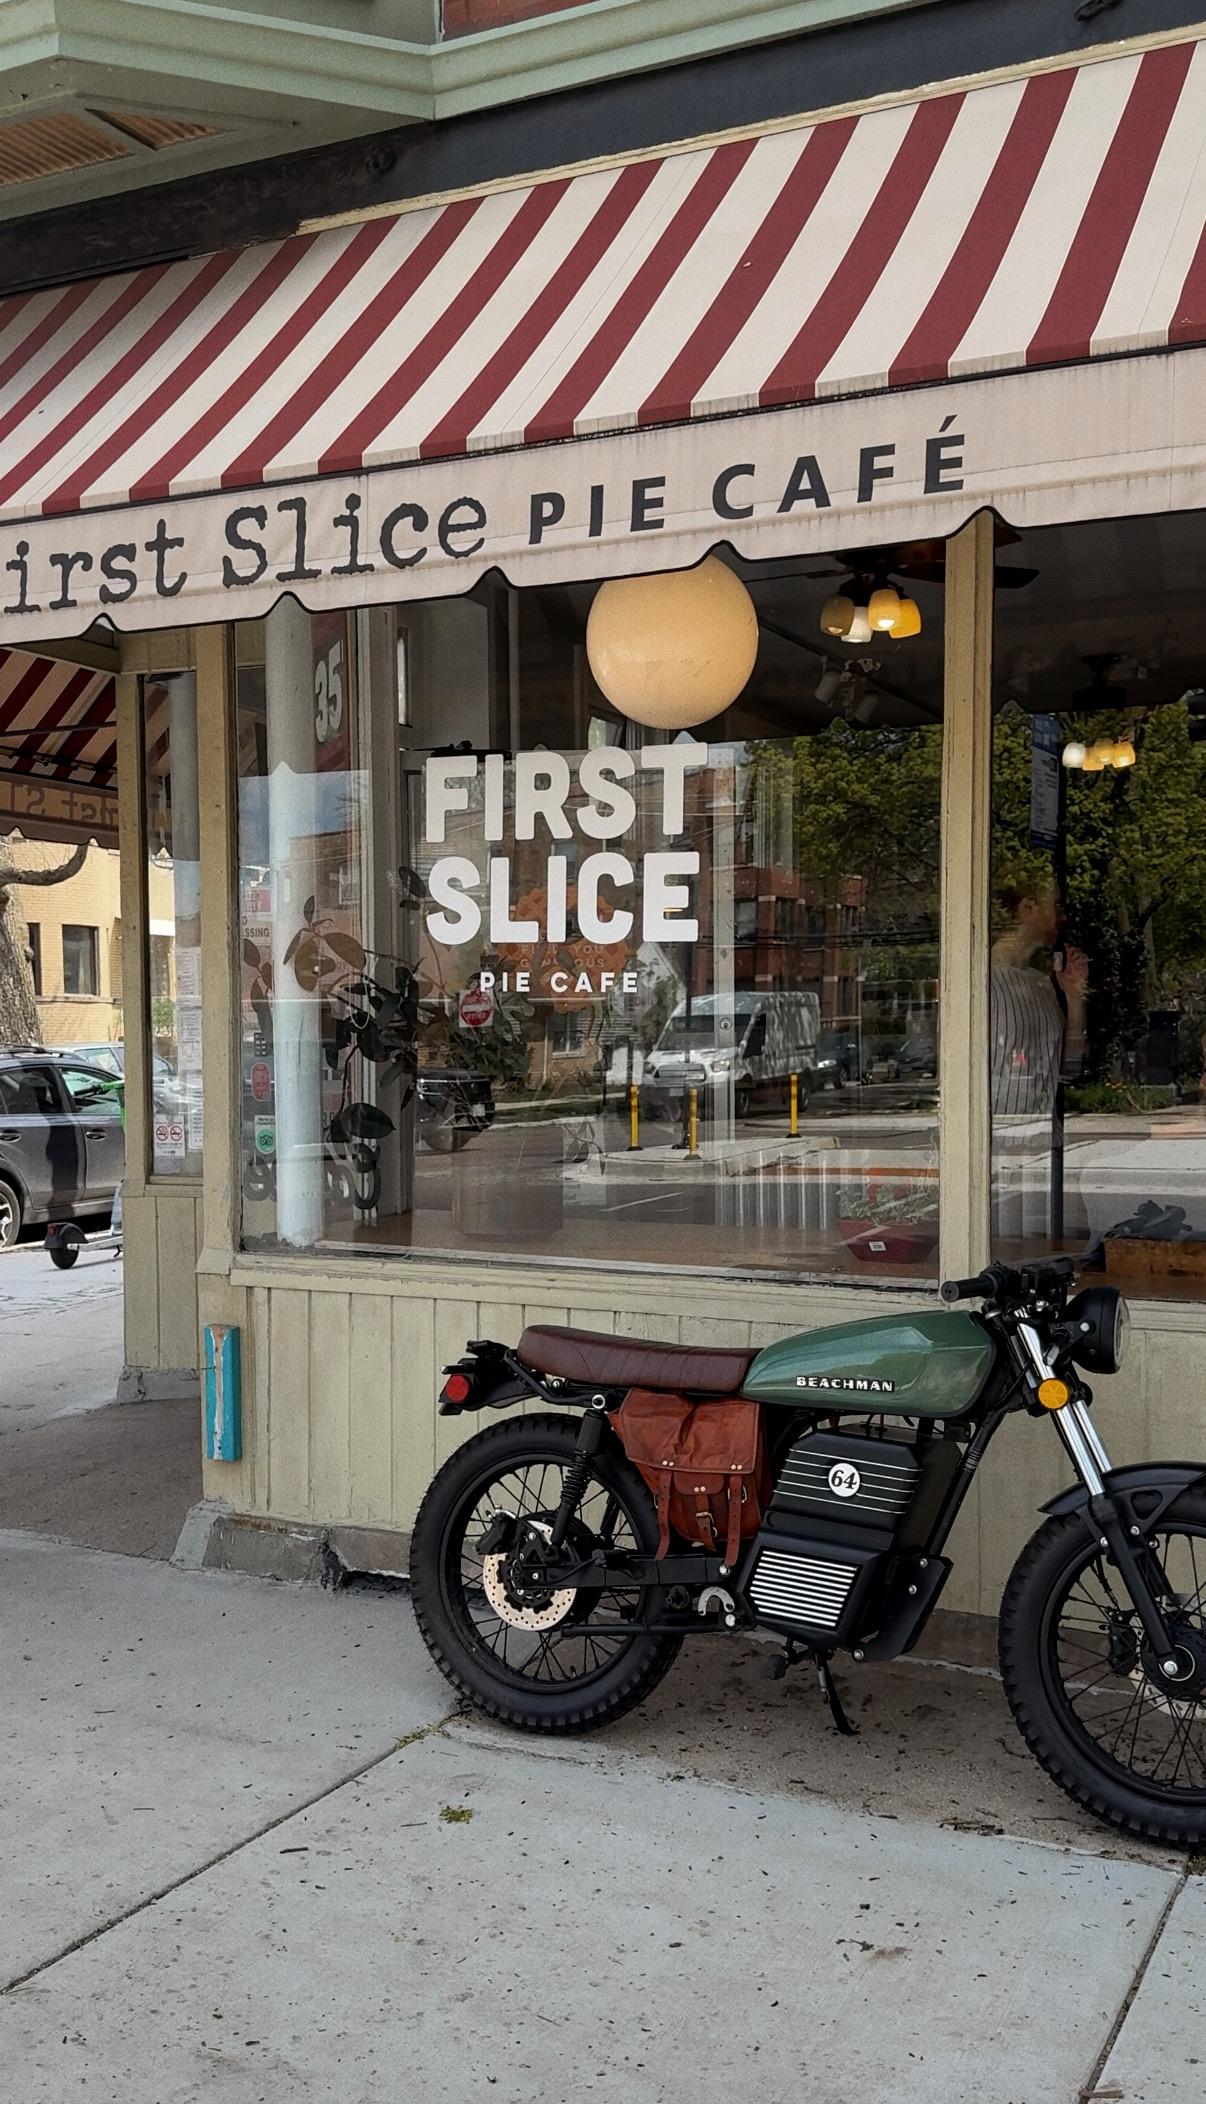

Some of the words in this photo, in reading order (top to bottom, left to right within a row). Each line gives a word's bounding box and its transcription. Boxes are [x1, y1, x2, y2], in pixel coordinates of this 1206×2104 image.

[4, 519, 187, 613] irst
[222, 493, 487, 589] Slice
[528, 475, 666, 545] PIE
[712, 414, 966, 521] CAFÉ
[315, 640, 344, 742] 35
[426, 743, 708, 843] FIRST
[426, 851, 700, 945] SLICE
[480, 972, 530, 992] PIE
[550, 972, 638, 993] CAFE
[796, 1376, 893, 1391] BEACHMAN
[831, 1469, 857, 1490] 64
